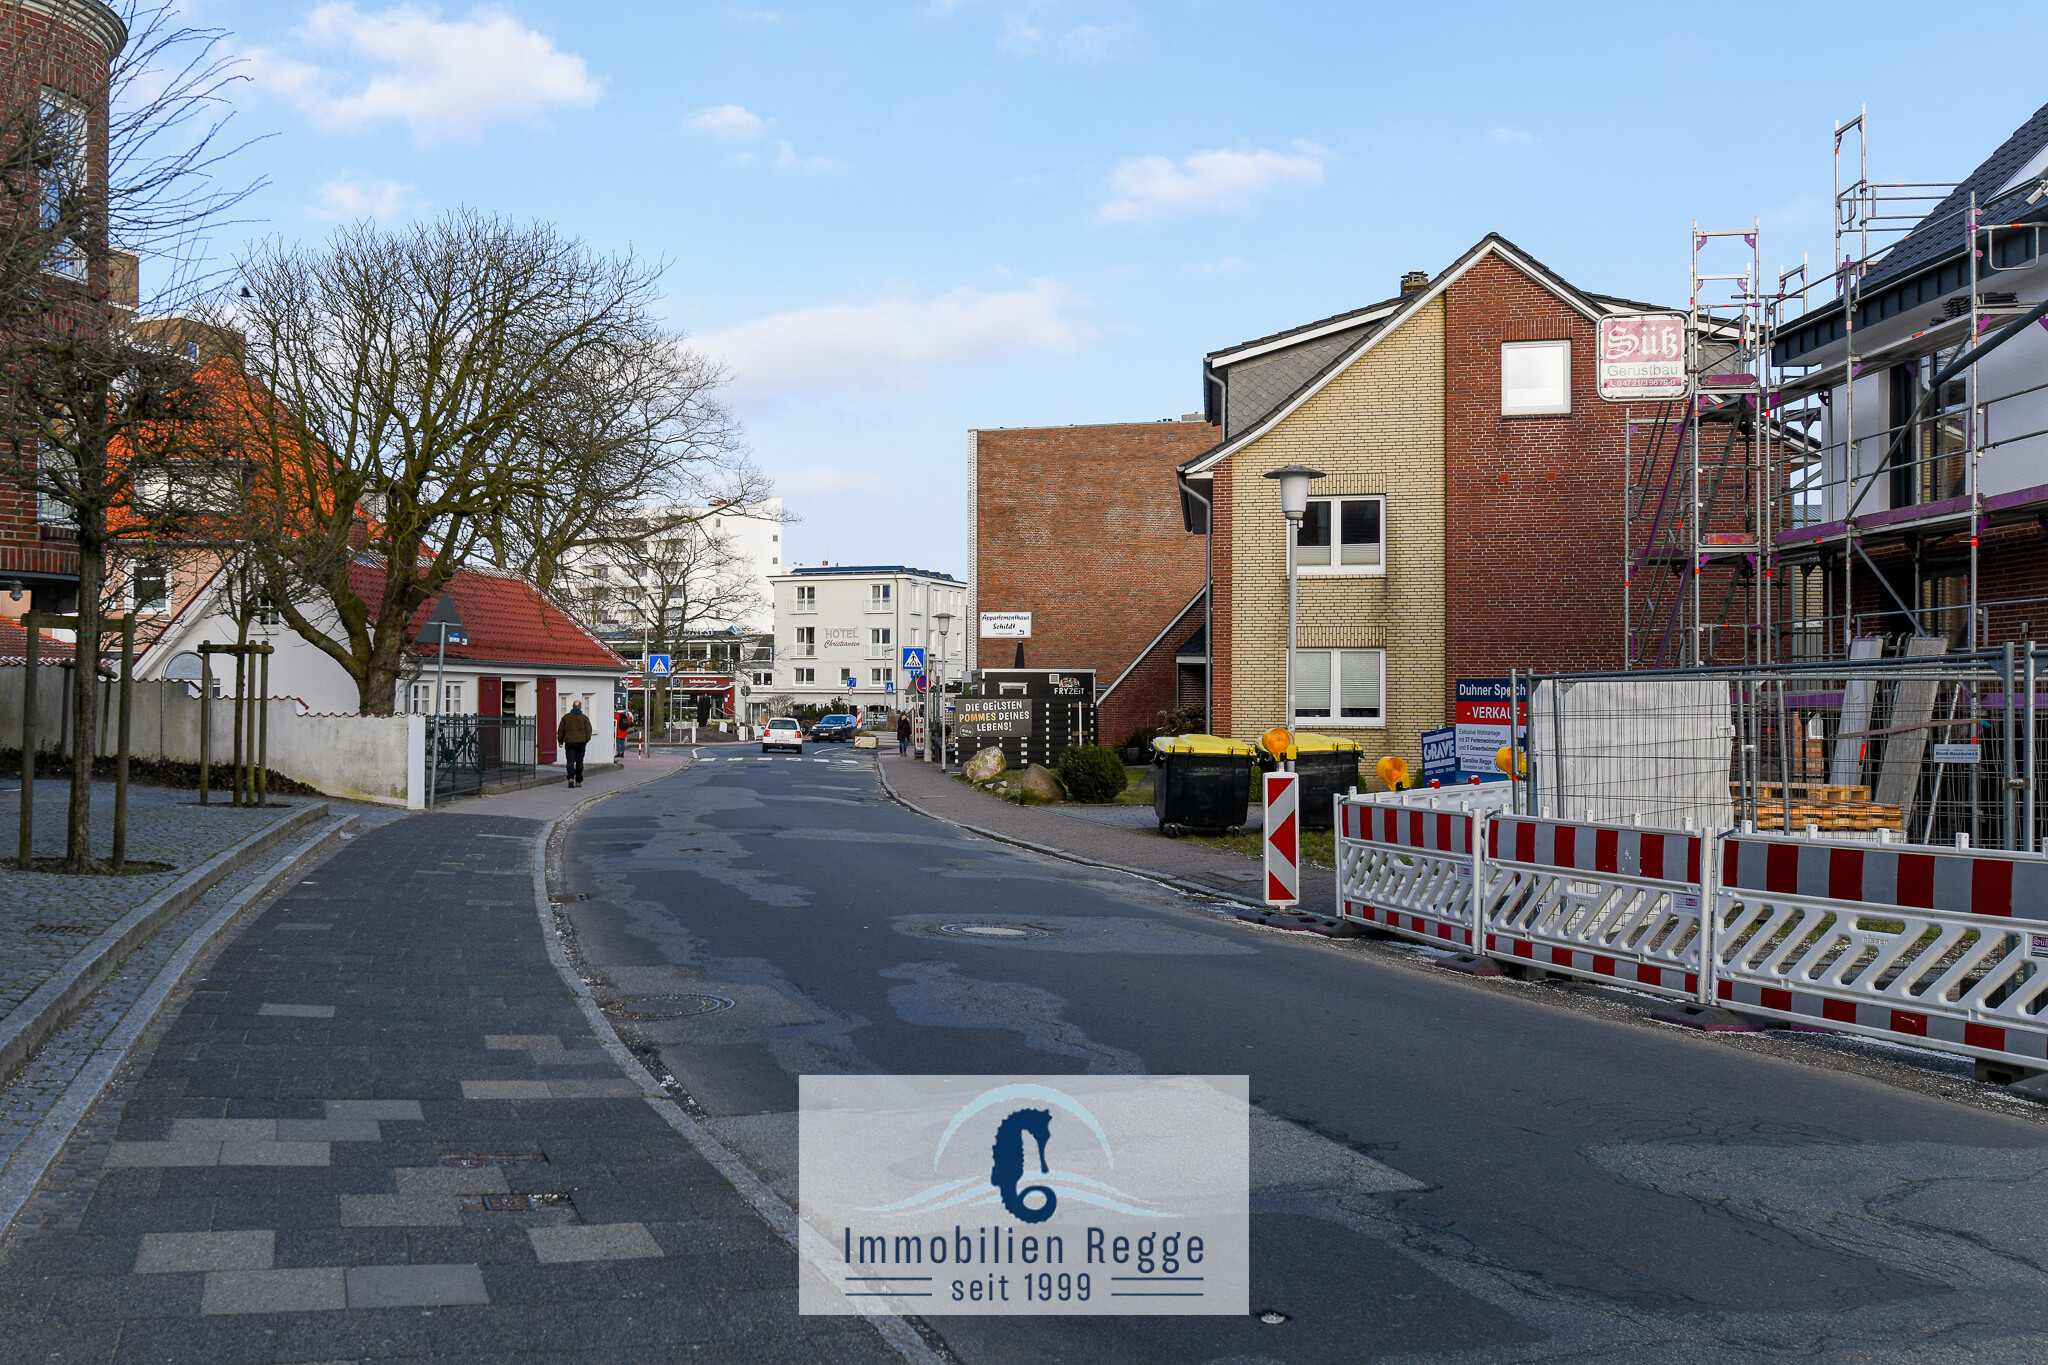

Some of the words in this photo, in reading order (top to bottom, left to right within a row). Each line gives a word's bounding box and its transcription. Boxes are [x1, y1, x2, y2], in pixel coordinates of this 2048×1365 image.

[1607, 364, 1678, 377] Gerüstbau
[825, 629, 859, 639] HOTEL
[823, 639, 861, 649] Christiansen
[1459, 683, 1493, 696] Duhner
[965, 703, 980, 712] DIE
[958, 712, 997, 723] POMMES
[998, 711, 1030, 721] DEINES
[976, 722, 1013, 732] LEBENS!
[1458, 728, 1476, 736] Exklusive
[1477, 729, 1501, 737] Wohnanlage
[1471, 737, 1507, 745] Ferienwohnungen
[1423, 739, 1455, 761] GRAVE
[1479, 758, 1493, 766] Regge
